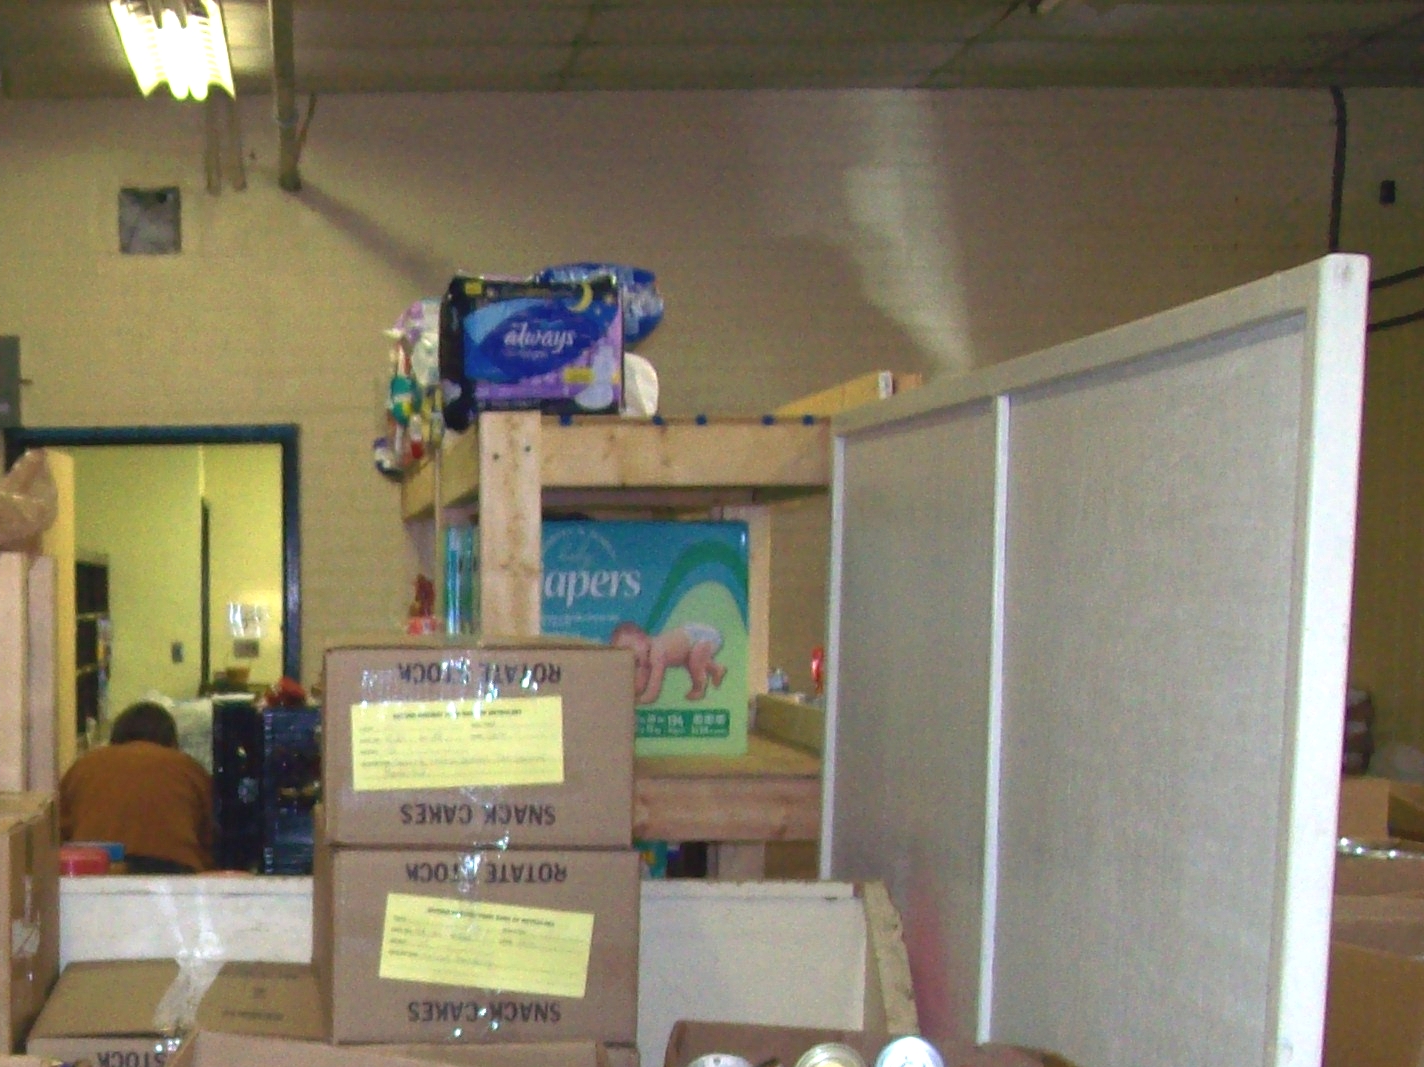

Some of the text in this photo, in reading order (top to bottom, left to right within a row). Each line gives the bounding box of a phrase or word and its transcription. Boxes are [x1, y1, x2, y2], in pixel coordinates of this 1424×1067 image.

[503, 321, 575, 355] always
[544, 569, 641, 607] apers
[400, 803, 556, 826] SNACK CAKES
[406, 861, 567, 884] ROTATE TOCK
[408, 1001, 562, 1023] SNACK CAKES
